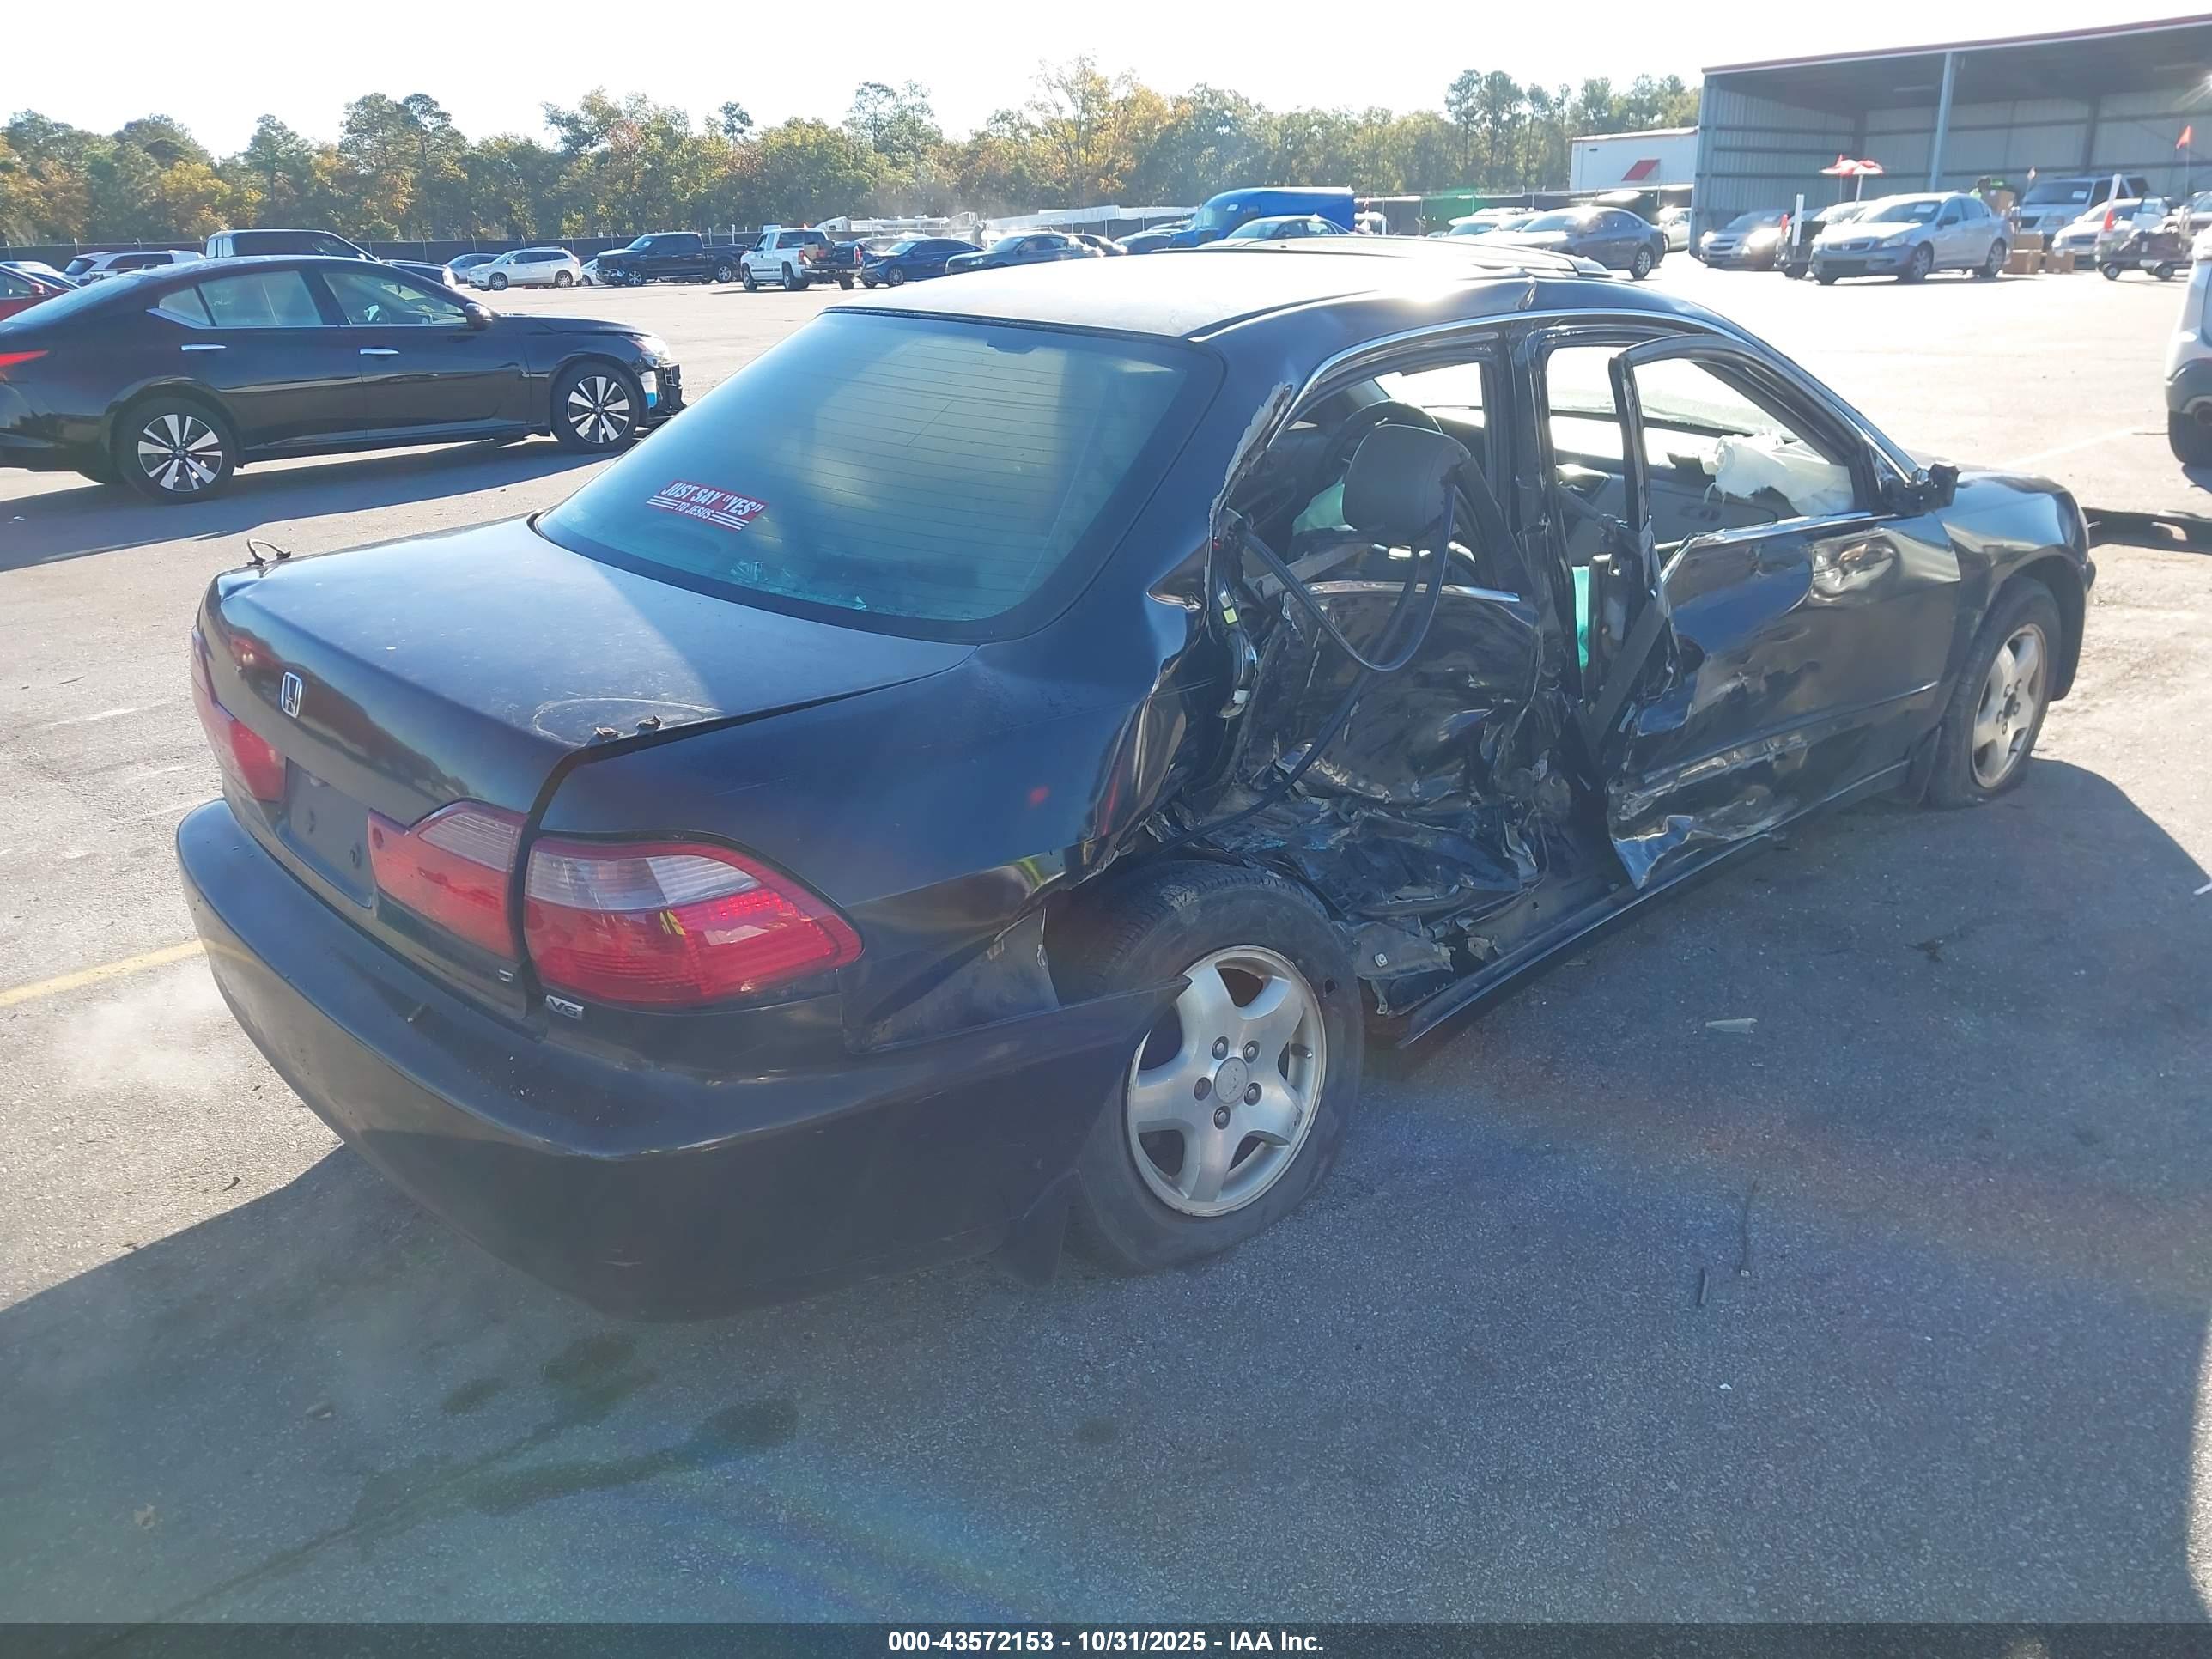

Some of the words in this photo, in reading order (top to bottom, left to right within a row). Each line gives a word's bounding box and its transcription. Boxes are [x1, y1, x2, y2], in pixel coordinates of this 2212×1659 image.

[660, 482, 700, 500] JUST
[690, 488, 725, 506] SAY
[675, 501, 686, 511] TO
[684, 504, 714, 519] JESUS
[545, 994, 585, 1020] V6
